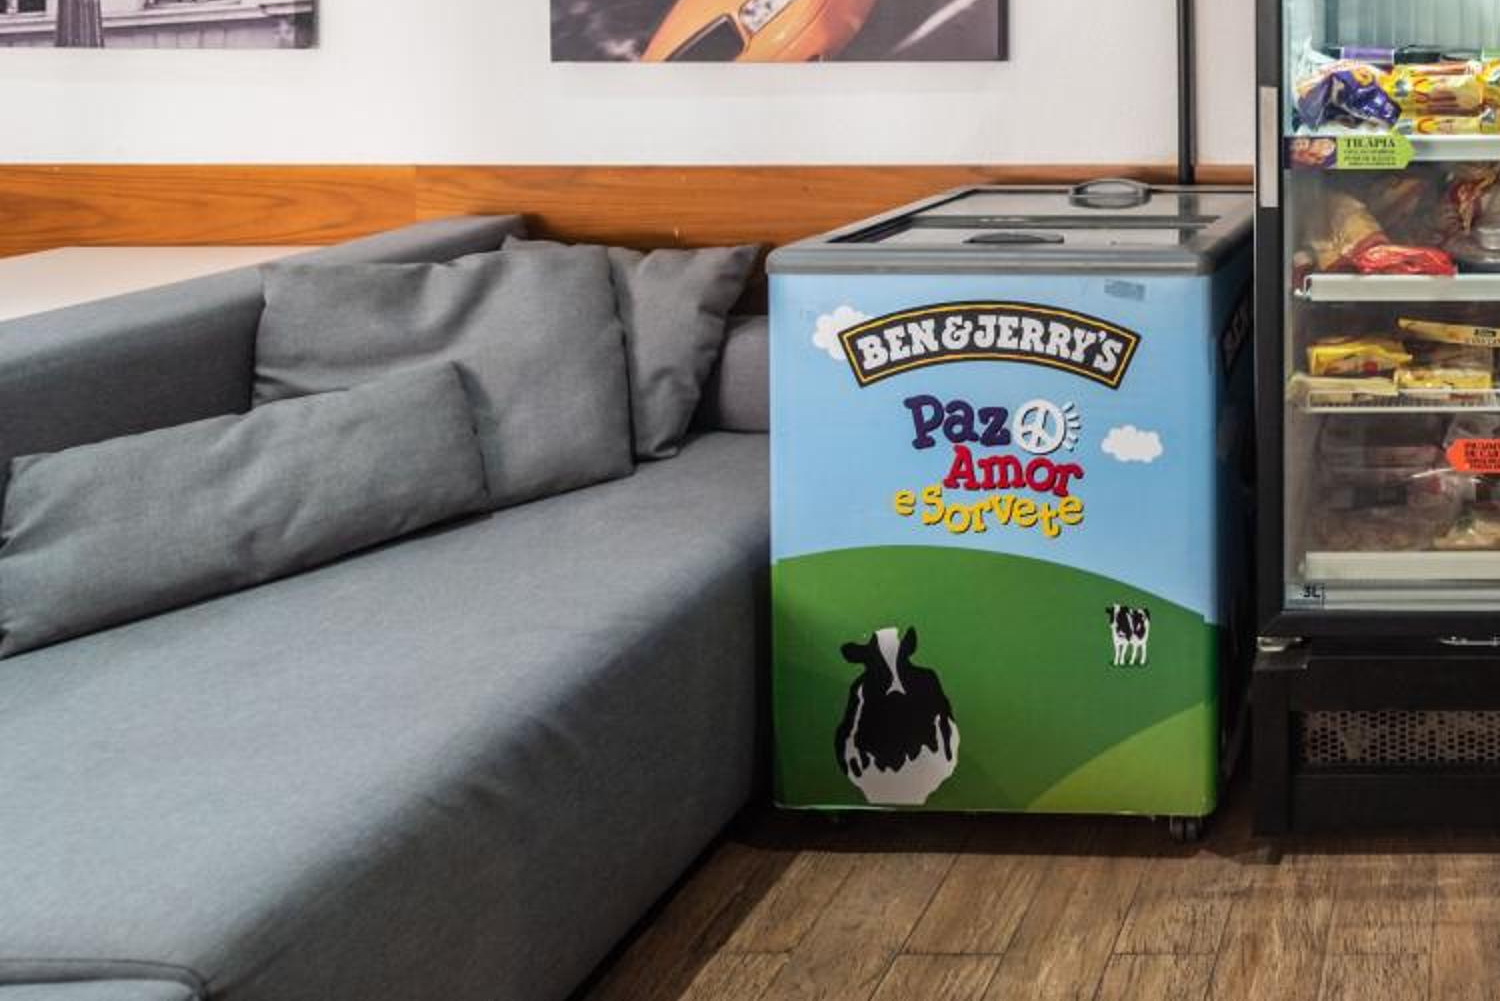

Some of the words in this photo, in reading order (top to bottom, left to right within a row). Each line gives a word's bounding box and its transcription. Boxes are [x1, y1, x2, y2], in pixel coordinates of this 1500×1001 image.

[856, 318, 939, 370] BEN
[973, 313, 1124, 373] JERRY'S
[903, 393, 1012, 450] Paz
[943, 443, 1084, 497] Amor
[894, 488, 917, 516] e
[921, 484, 1084, 539] Sorvete
